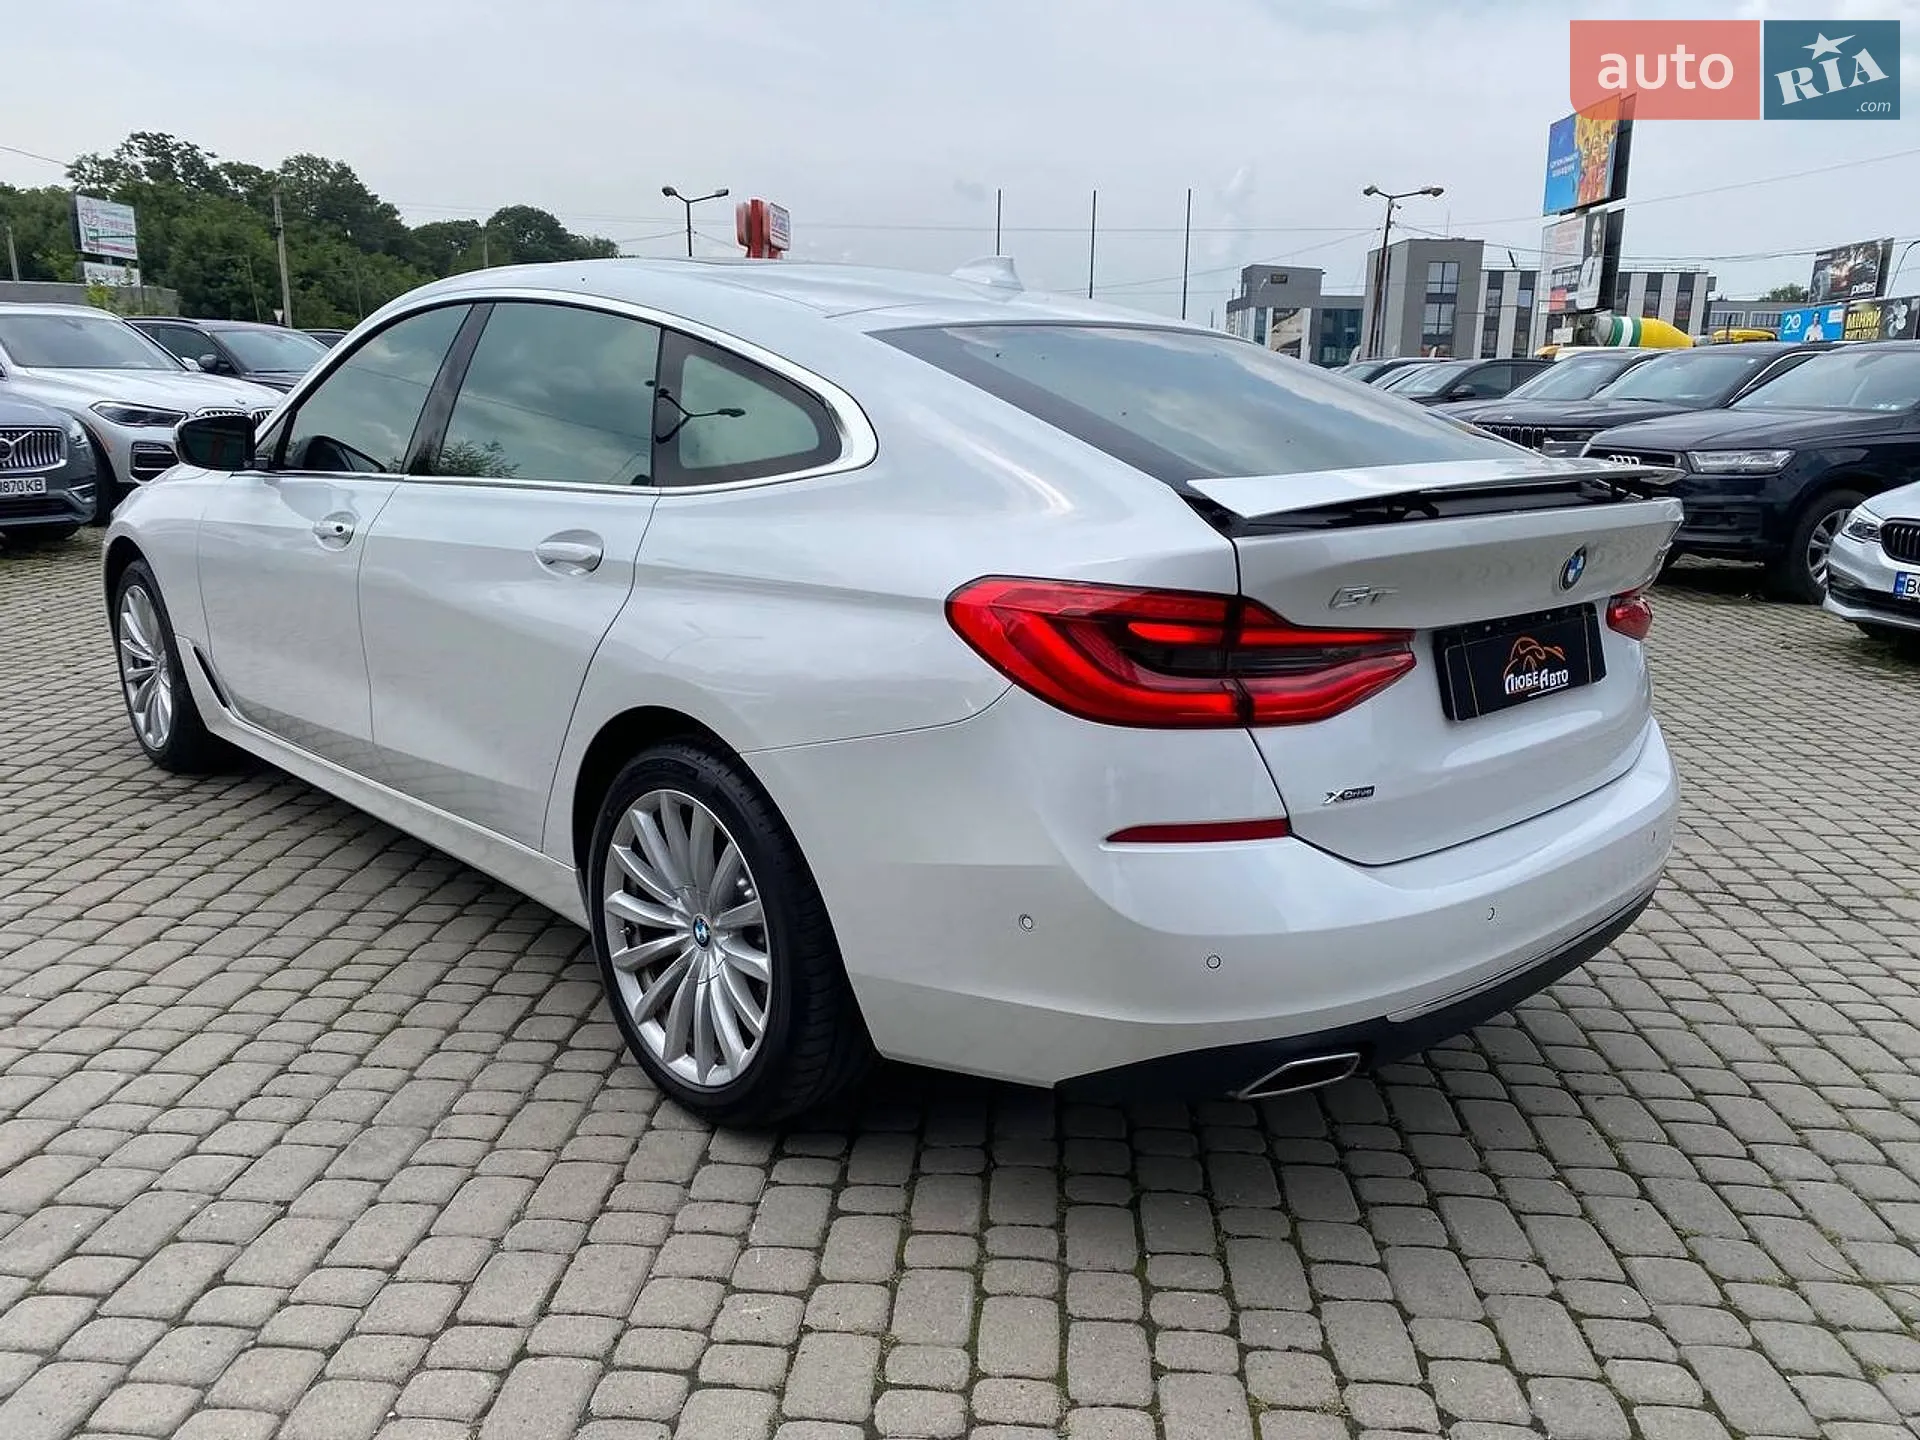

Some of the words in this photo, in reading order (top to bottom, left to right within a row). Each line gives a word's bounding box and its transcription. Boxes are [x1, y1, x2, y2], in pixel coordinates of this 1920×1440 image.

[1784, 313, 1801, 329] 20
[0, 480, 43, 493] 870KB
[1905, 578, 1920, 594] B
